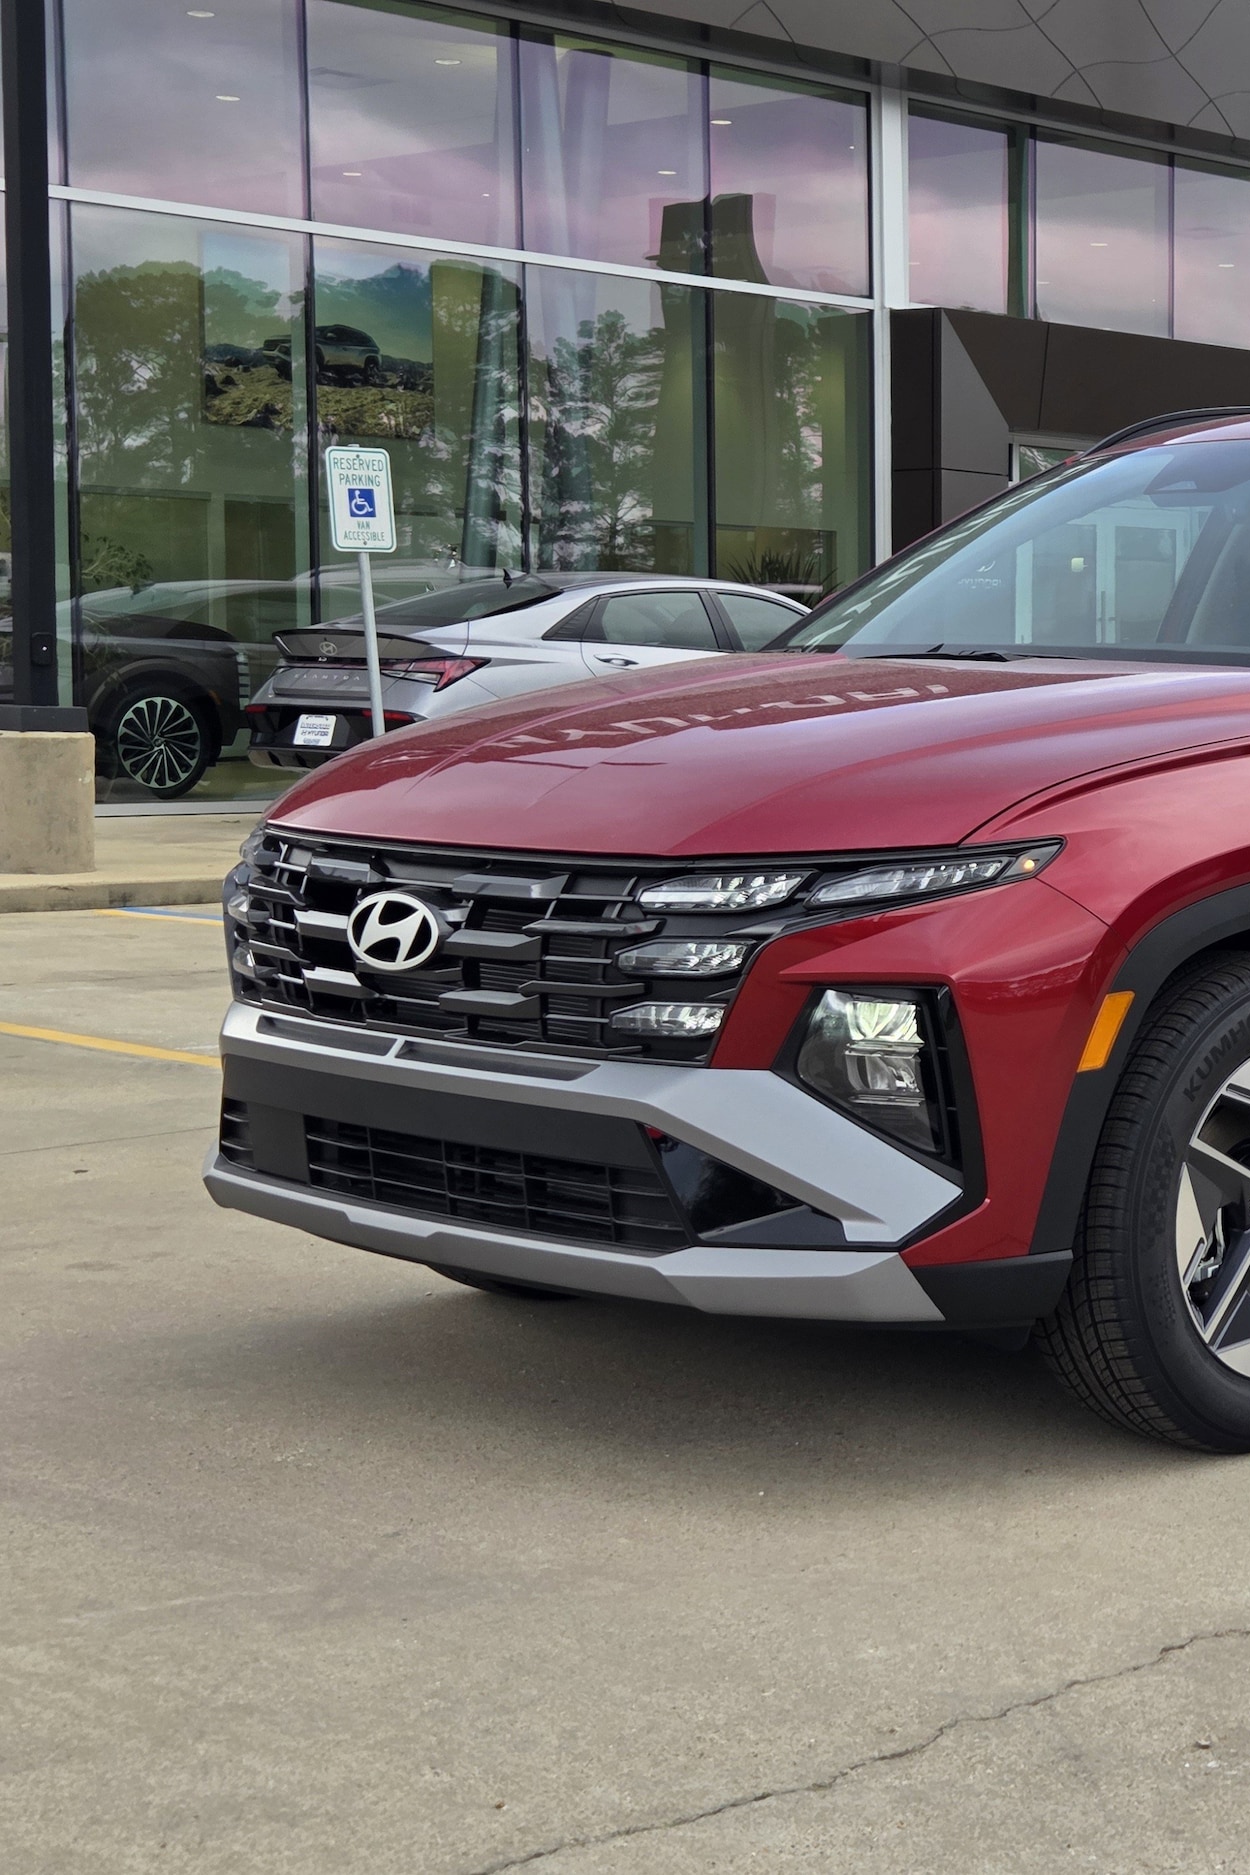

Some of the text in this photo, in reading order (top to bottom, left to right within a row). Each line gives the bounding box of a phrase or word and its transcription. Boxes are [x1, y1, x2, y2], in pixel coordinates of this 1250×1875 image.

[333, 457, 384, 471] RESERVED
[339, 473, 381, 487] PARKING
[356, 520, 371, 529] VAN
[343, 531, 385, 541] ACCESSIBLE
